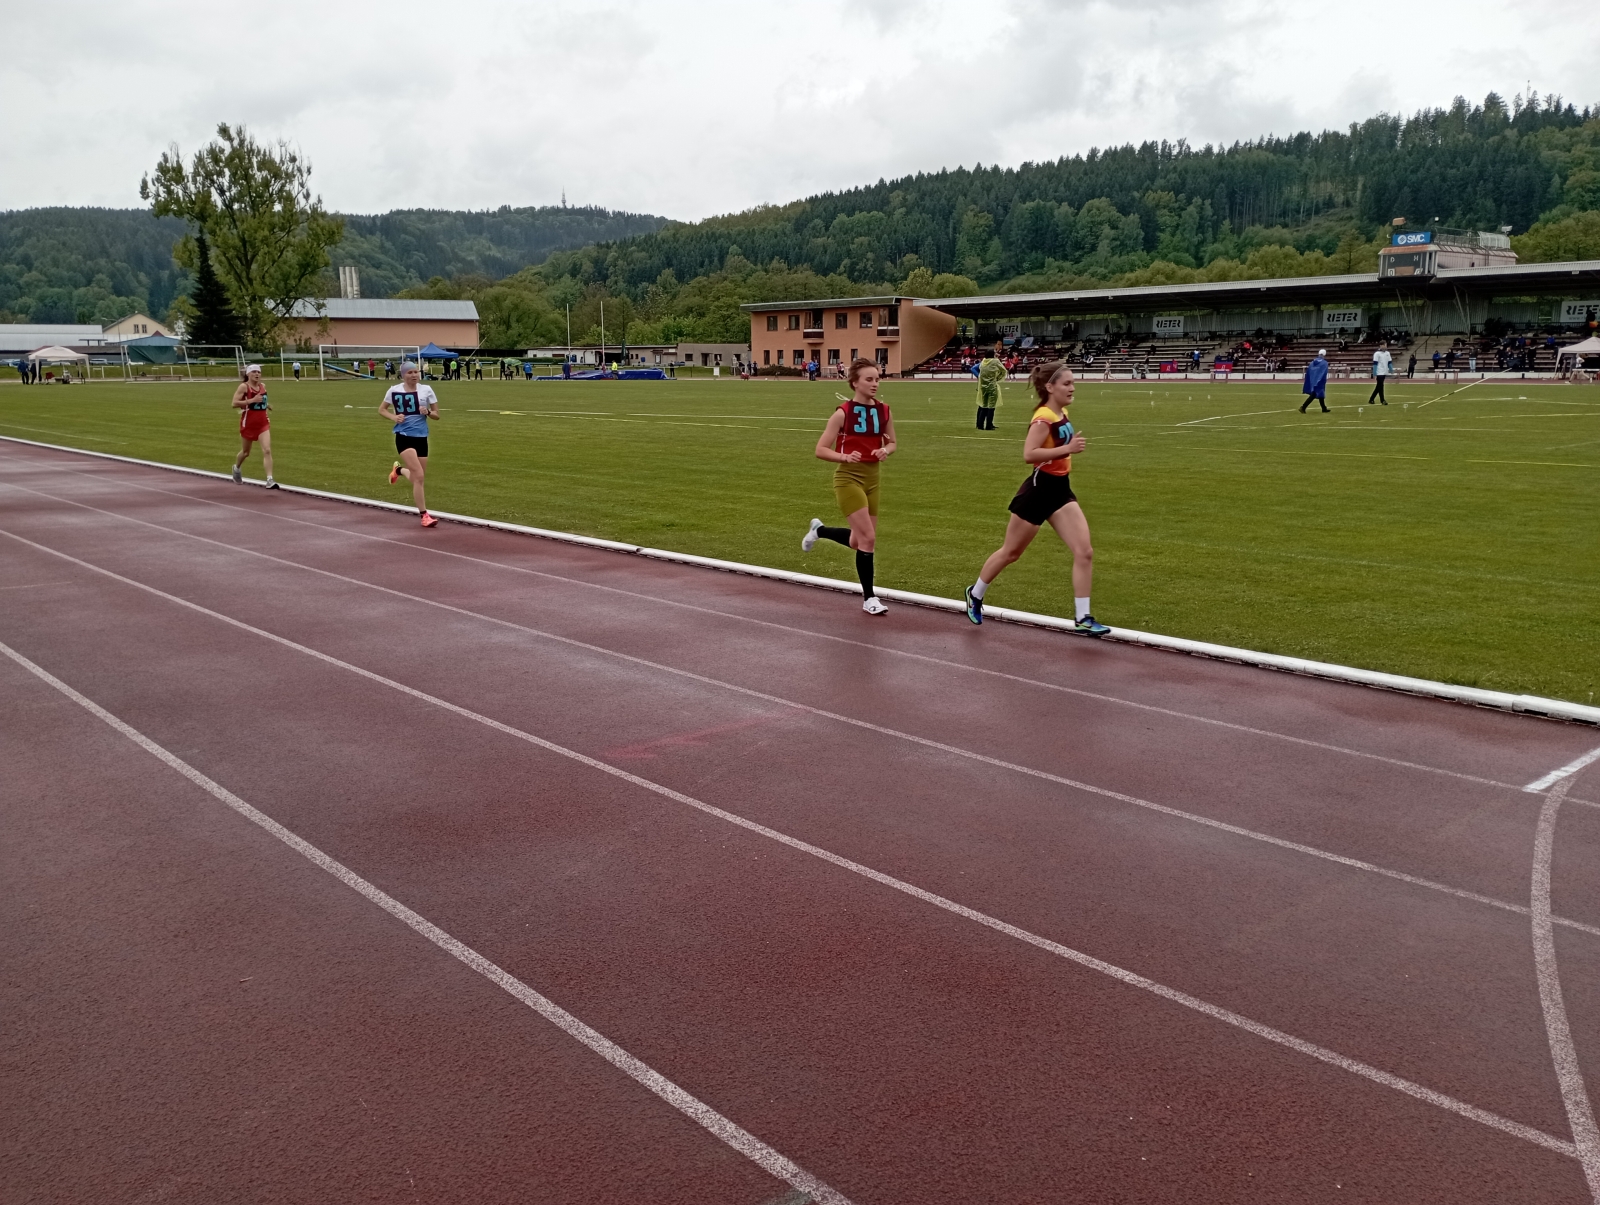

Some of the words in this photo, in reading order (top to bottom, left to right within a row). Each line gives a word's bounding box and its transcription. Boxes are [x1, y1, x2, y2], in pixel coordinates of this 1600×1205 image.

[1407, 233, 1425, 243] SMC
[1566, 304, 1600, 315] RIETE
[1326, 312, 1358, 322] RIETER
[1156, 319, 1181, 328] RIETER
[394, 394, 416, 413] 33
[853, 405, 880, 434] 31
